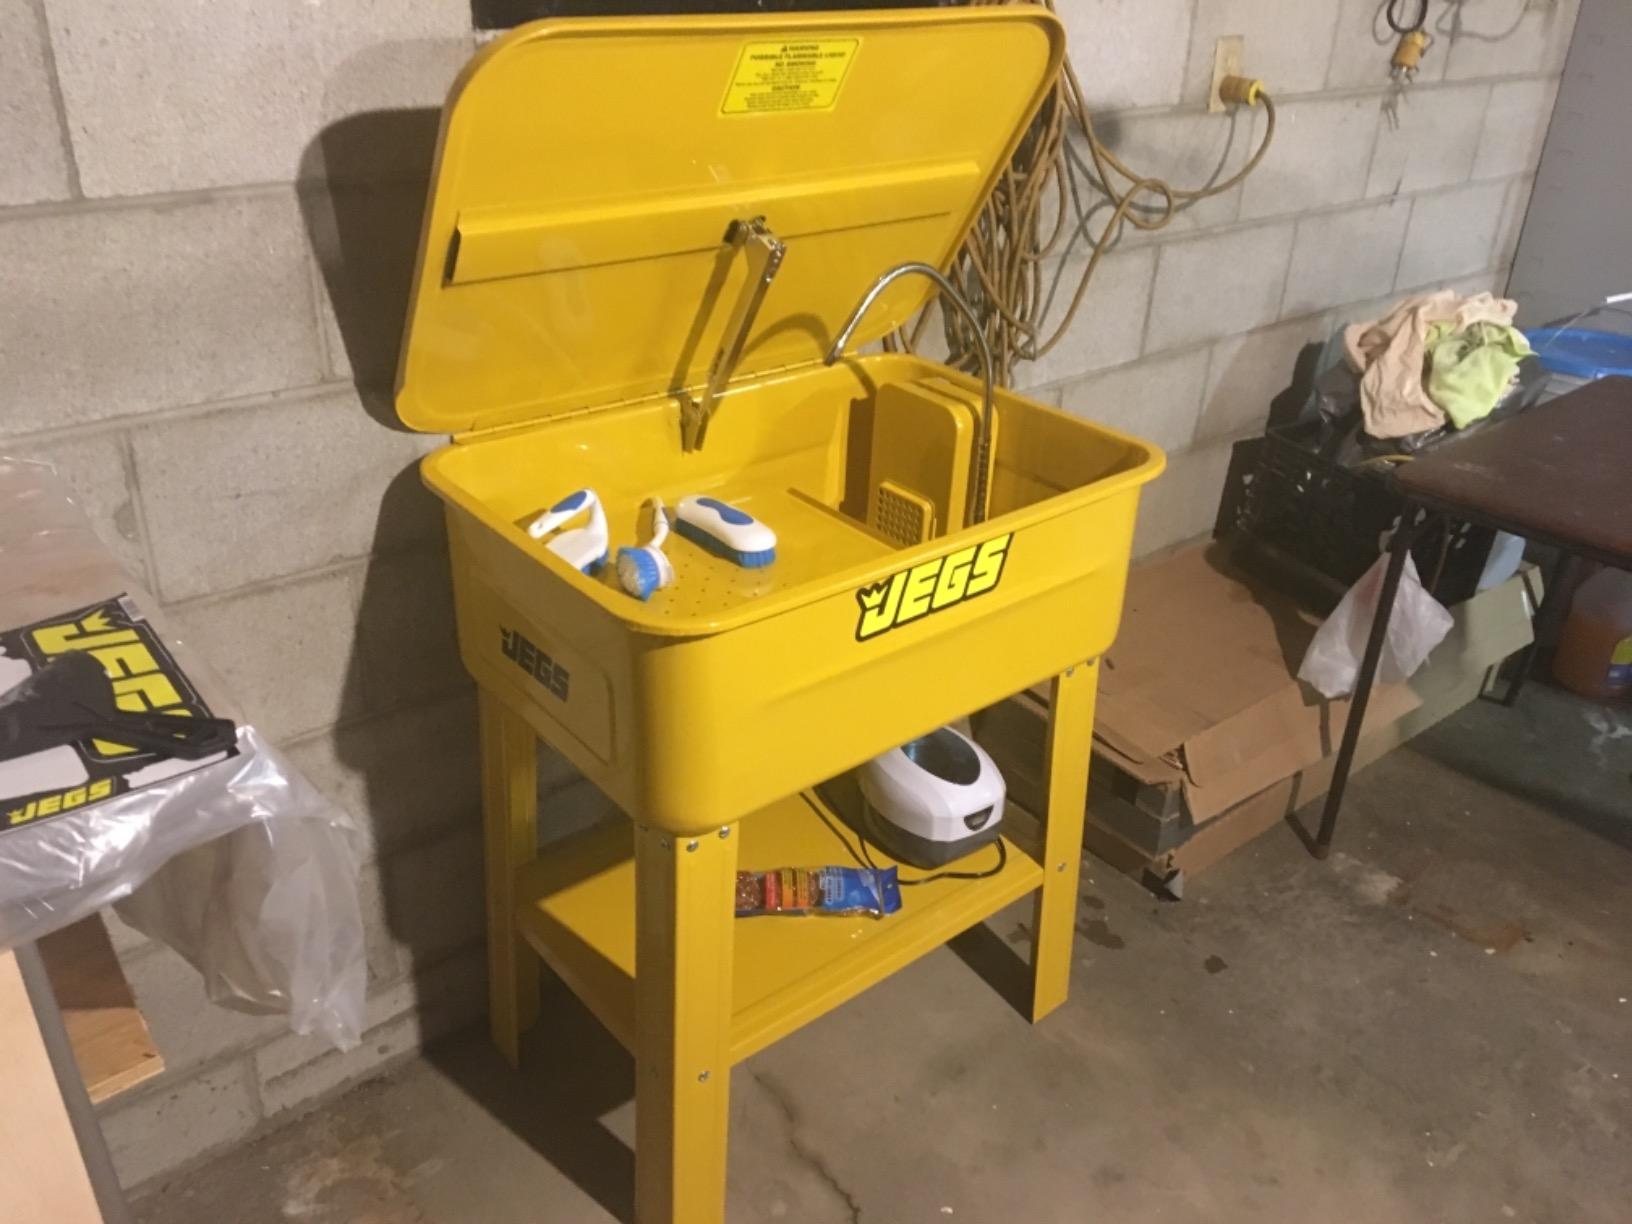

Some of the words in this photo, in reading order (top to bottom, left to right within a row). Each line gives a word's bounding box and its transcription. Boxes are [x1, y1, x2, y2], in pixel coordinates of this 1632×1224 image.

[857, 533, 1014, 642] JEGS
[499, 624, 570, 703] JEGS
[7, 779, 112, 825] JEGS
